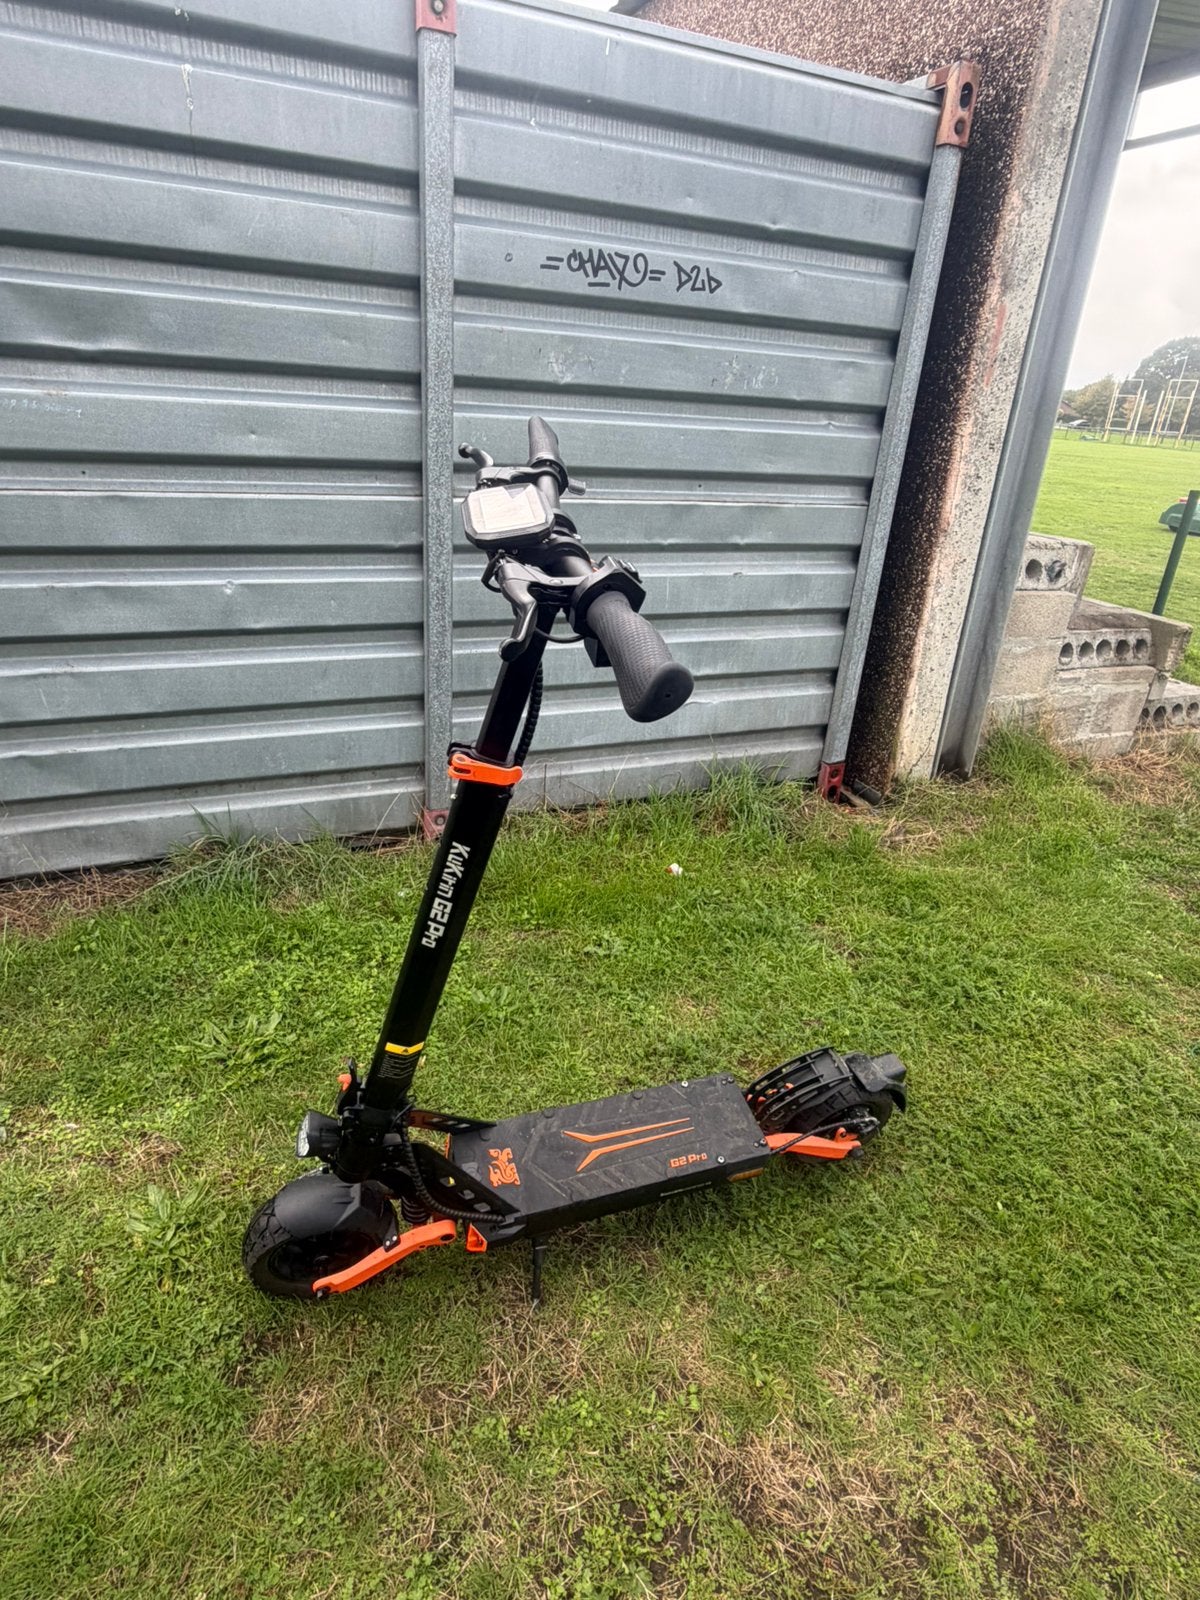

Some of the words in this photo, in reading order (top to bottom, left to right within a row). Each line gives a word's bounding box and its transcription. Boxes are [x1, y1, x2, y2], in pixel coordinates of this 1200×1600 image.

[437, 841, 471, 898] KuKirin
[429, 897, 453, 924] G2
[421, 920, 446, 949] Pro
[669, 1156, 688, 1168] G2
[687, 1152, 708, 1164] Pro
